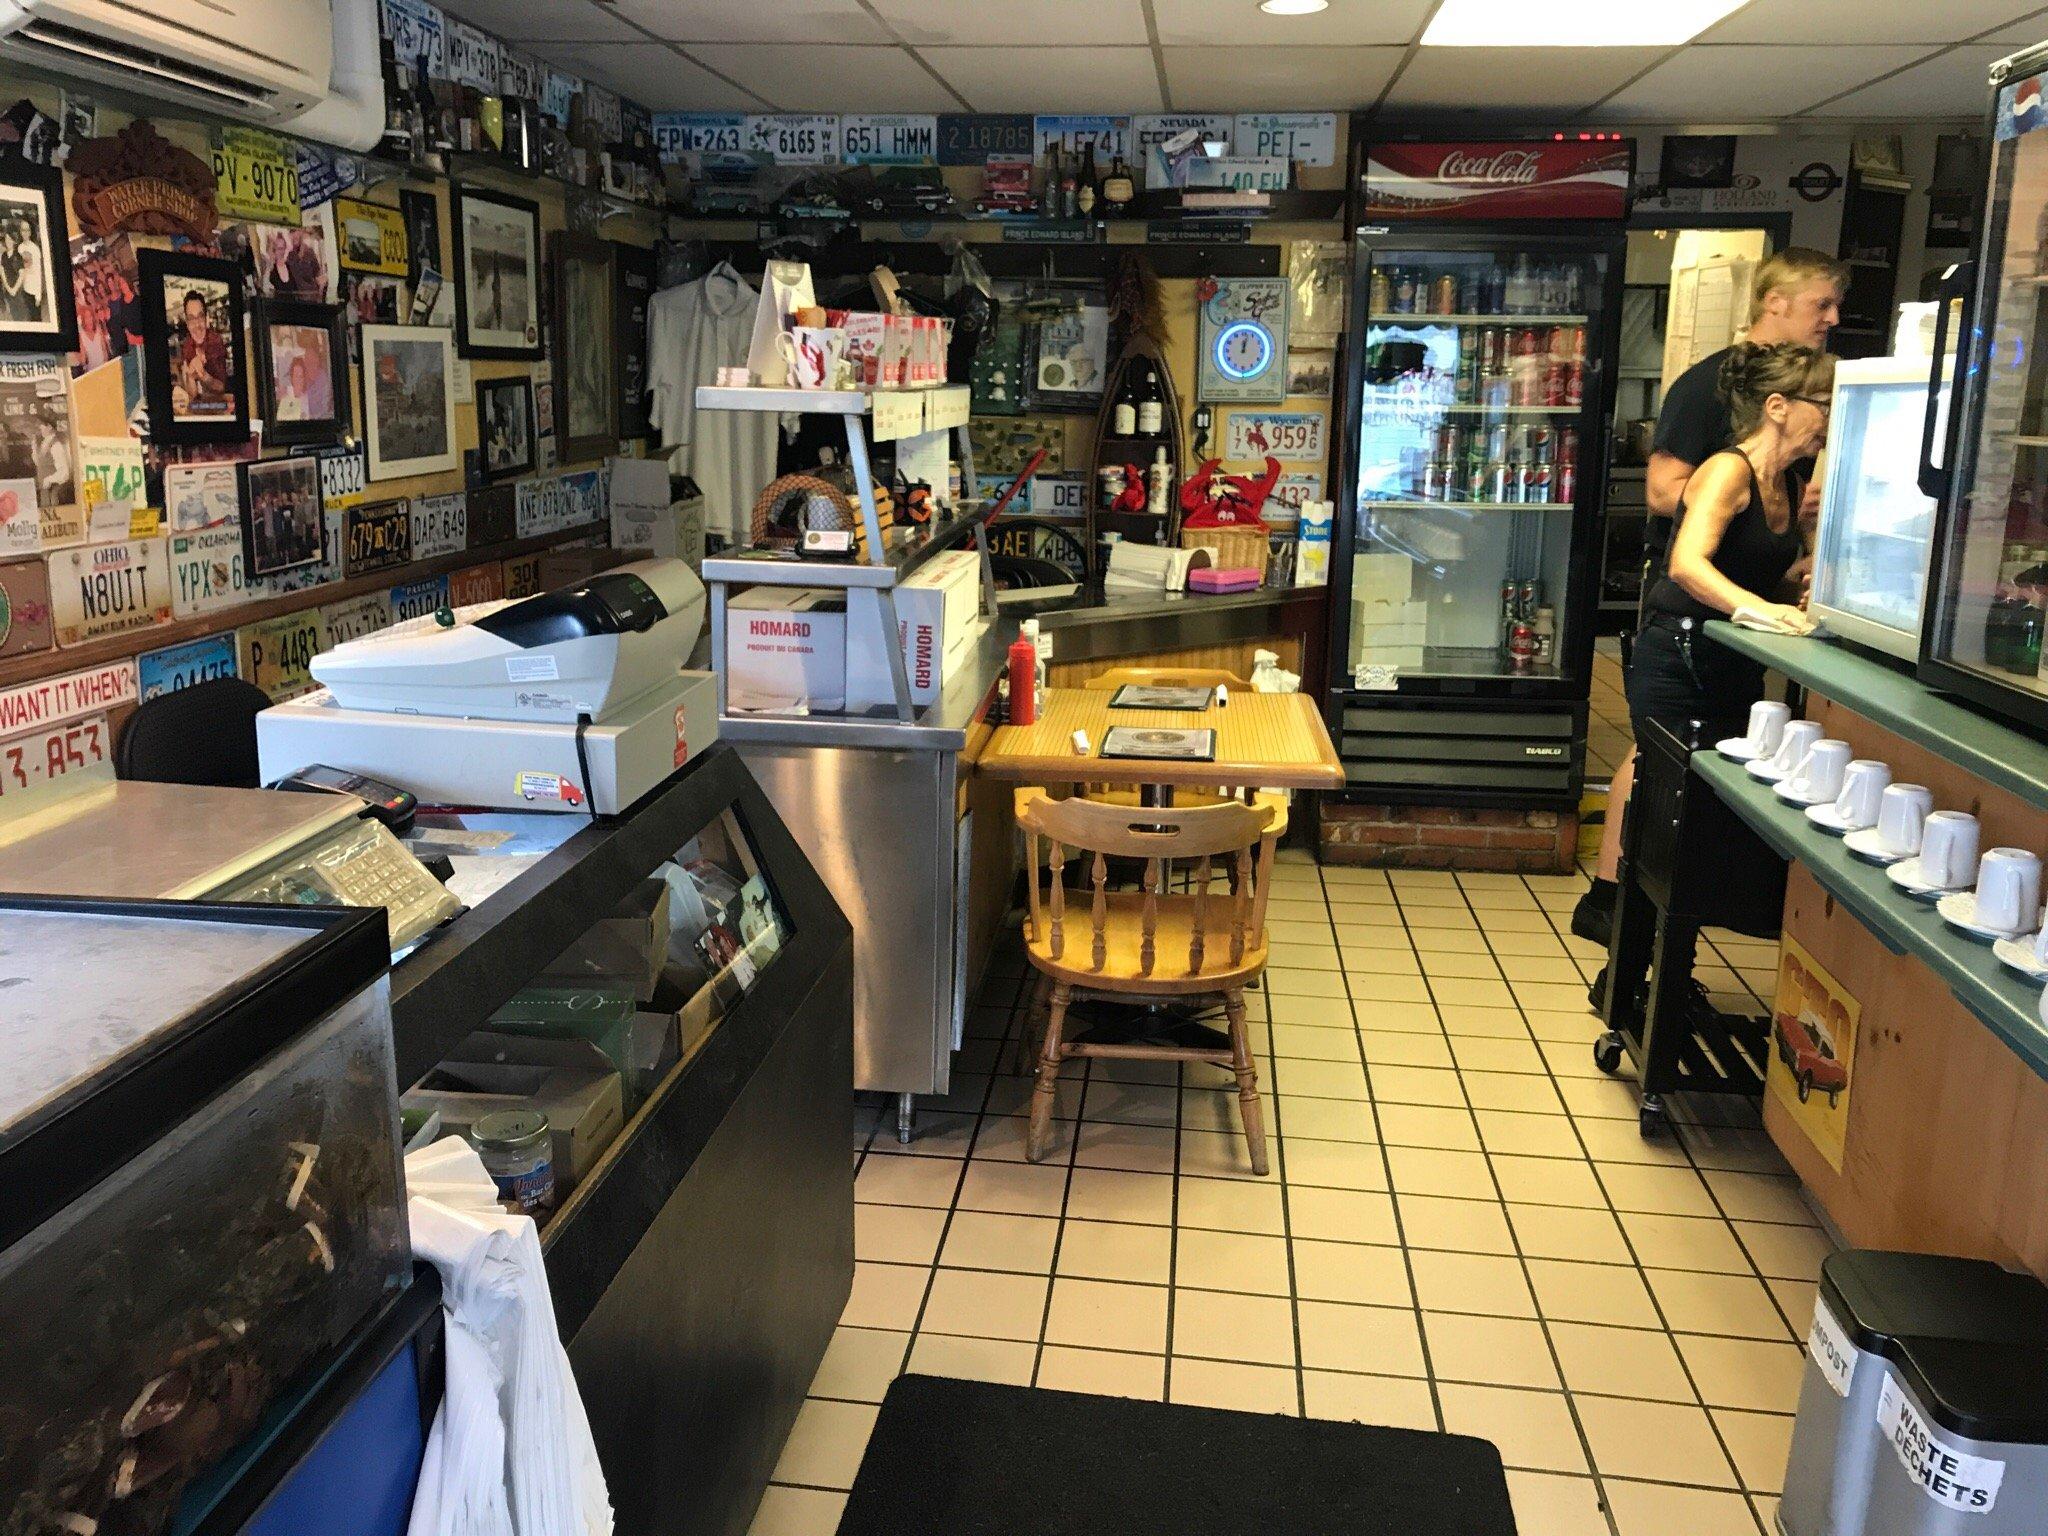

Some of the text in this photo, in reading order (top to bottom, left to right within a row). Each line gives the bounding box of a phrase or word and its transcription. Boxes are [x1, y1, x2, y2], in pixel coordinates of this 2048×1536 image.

[1159, 118, 1207, 128] NEVADA
[703, 128, 740, 151] 263
[778, 129, 816, 154] 6165
[846, 127, 932, 155] 651 HMM
[1437, 149, 1544, 184] Coca-Cola
[6, 361, 35, 378] FRESH
[1271, 425, 1307, 450] 959
[7, 520, 38, 540] Molly
[40, 521, 79, 540] ALIBUT
[442, 508, 465, 539] 649
[198, 531, 241, 550] OKLAHOMA
[350, 520, 374, 561] 679
[94, 546, 130, 565] OHIO
[177, 558, 212, 602] YPX
[80, 565, 148, 621] N8UIT
[750, 619, 811, 638] HOMARD
[788, 645, 814, 654] CANADA
[915, 624, 933, 690] HOMARD
[251, 640, 263, 685] P
[0, 685, 50, 730] WANT
[55, 682, 74, 712] IT
[75, 666, 130, 709] WHEN?
[1899, 1402, 1960, 1477] WASTE
